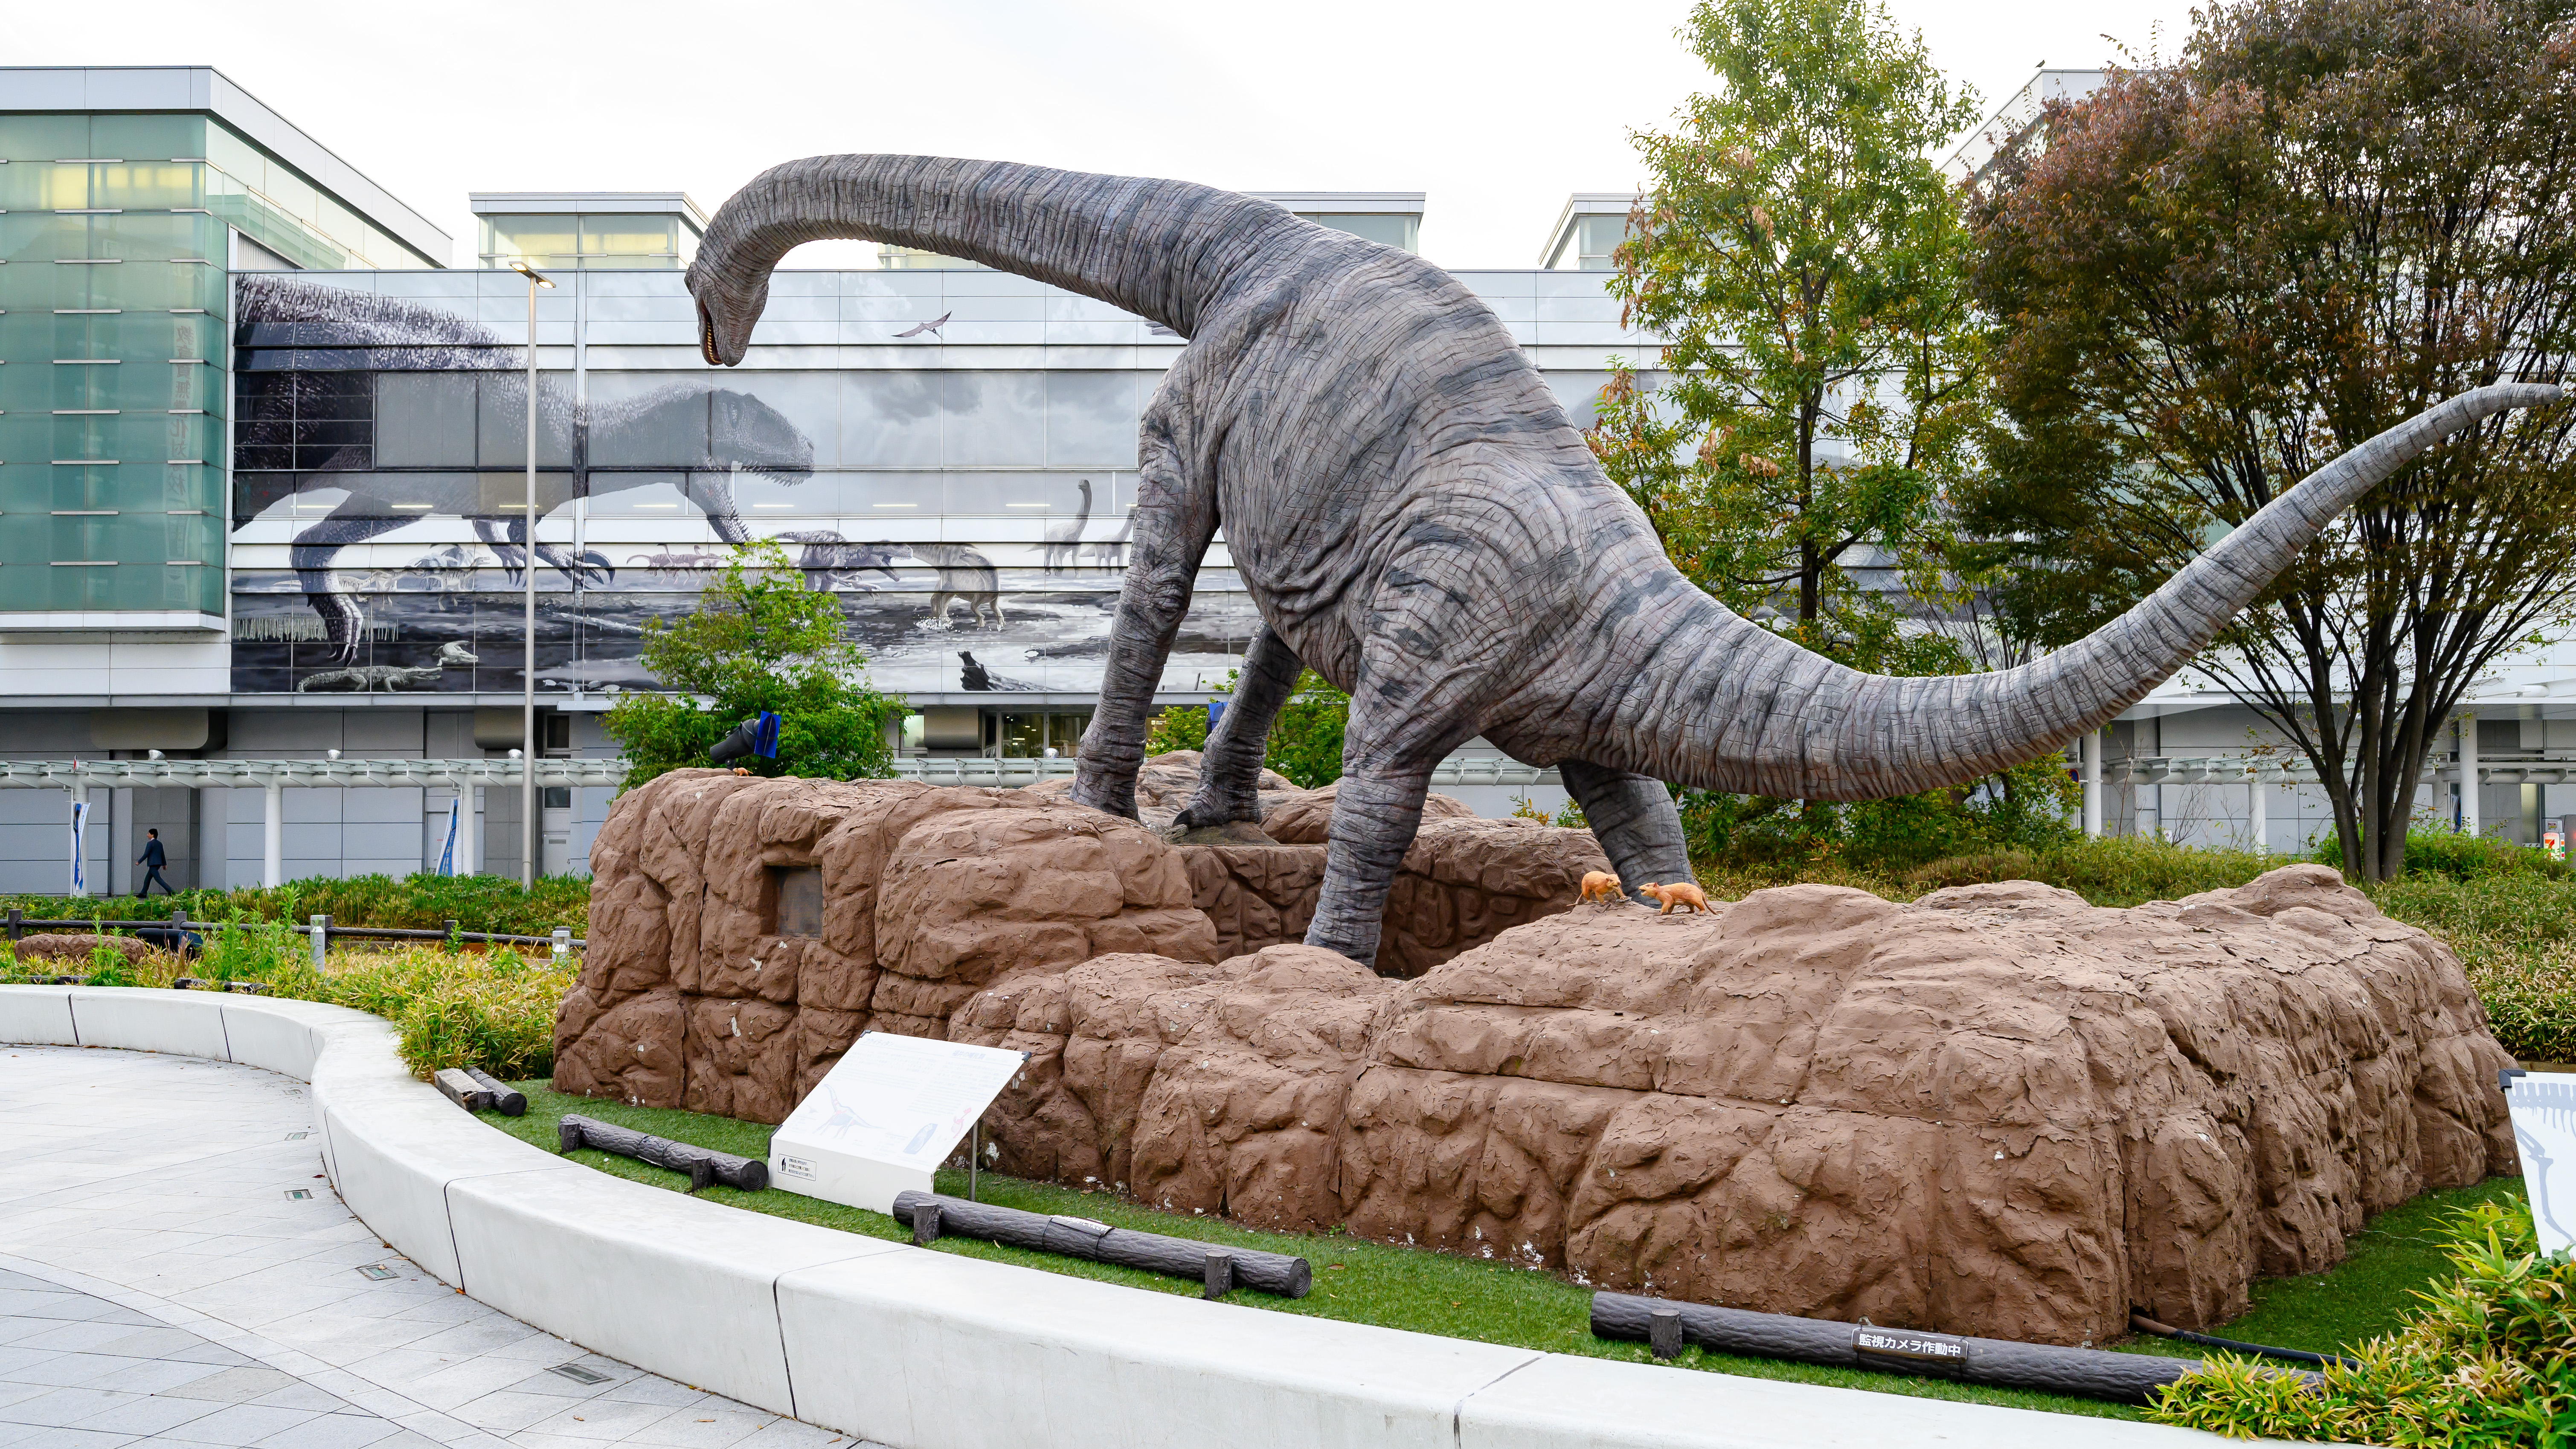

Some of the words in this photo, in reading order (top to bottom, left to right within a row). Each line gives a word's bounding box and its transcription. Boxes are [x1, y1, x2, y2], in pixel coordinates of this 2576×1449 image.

[1859, 1333, 1961, 1356] 監視カメラ作動中
